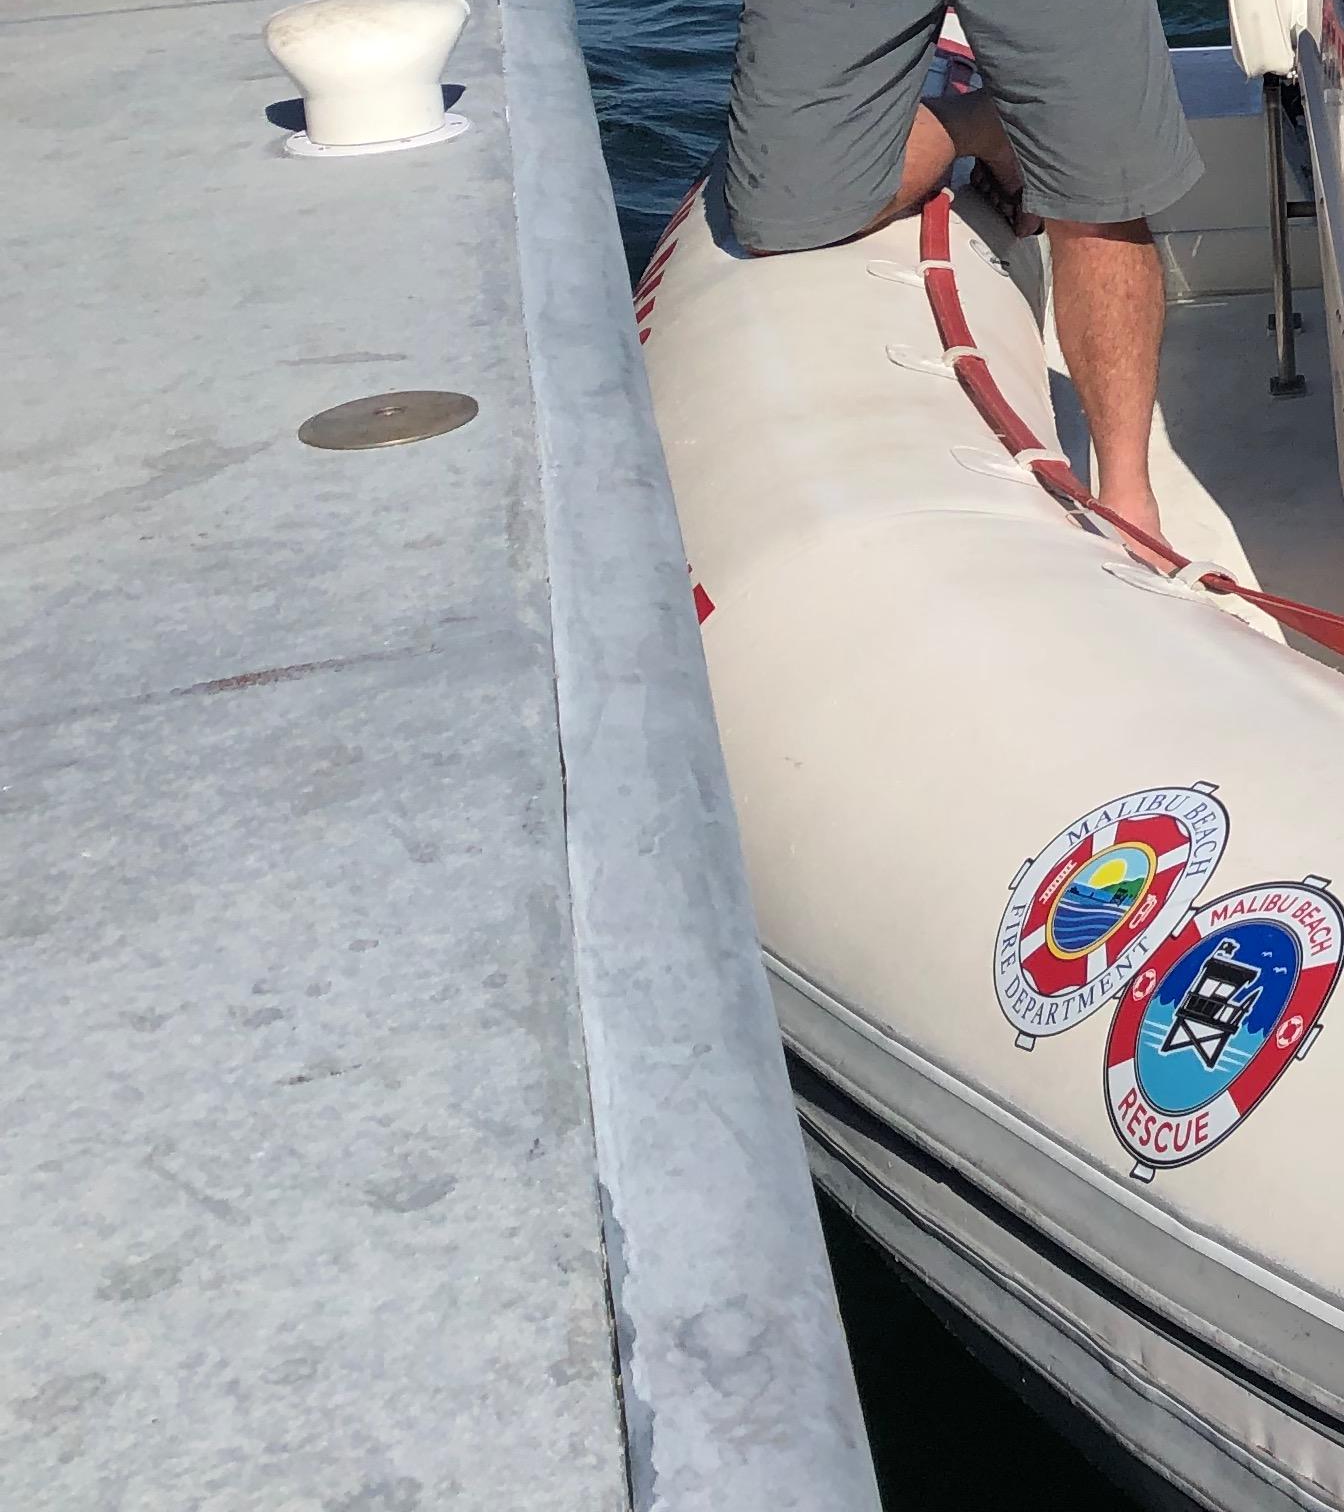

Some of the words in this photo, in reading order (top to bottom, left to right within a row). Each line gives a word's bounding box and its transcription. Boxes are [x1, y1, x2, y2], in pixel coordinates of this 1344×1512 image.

[1066, 793, 1185, 847] MALIBU
[1182, 801, 1217, 878] BEACH
[1000, 903, 1027, 976] FIRE
[1209, 893, 1294, 928] MALIBU
[1291, 901, 1334, 958] BEACH
[1003, 936, 1151, 1028] DEPARTMENT
[1117, 1087, 1212, 1153] RESCUE
